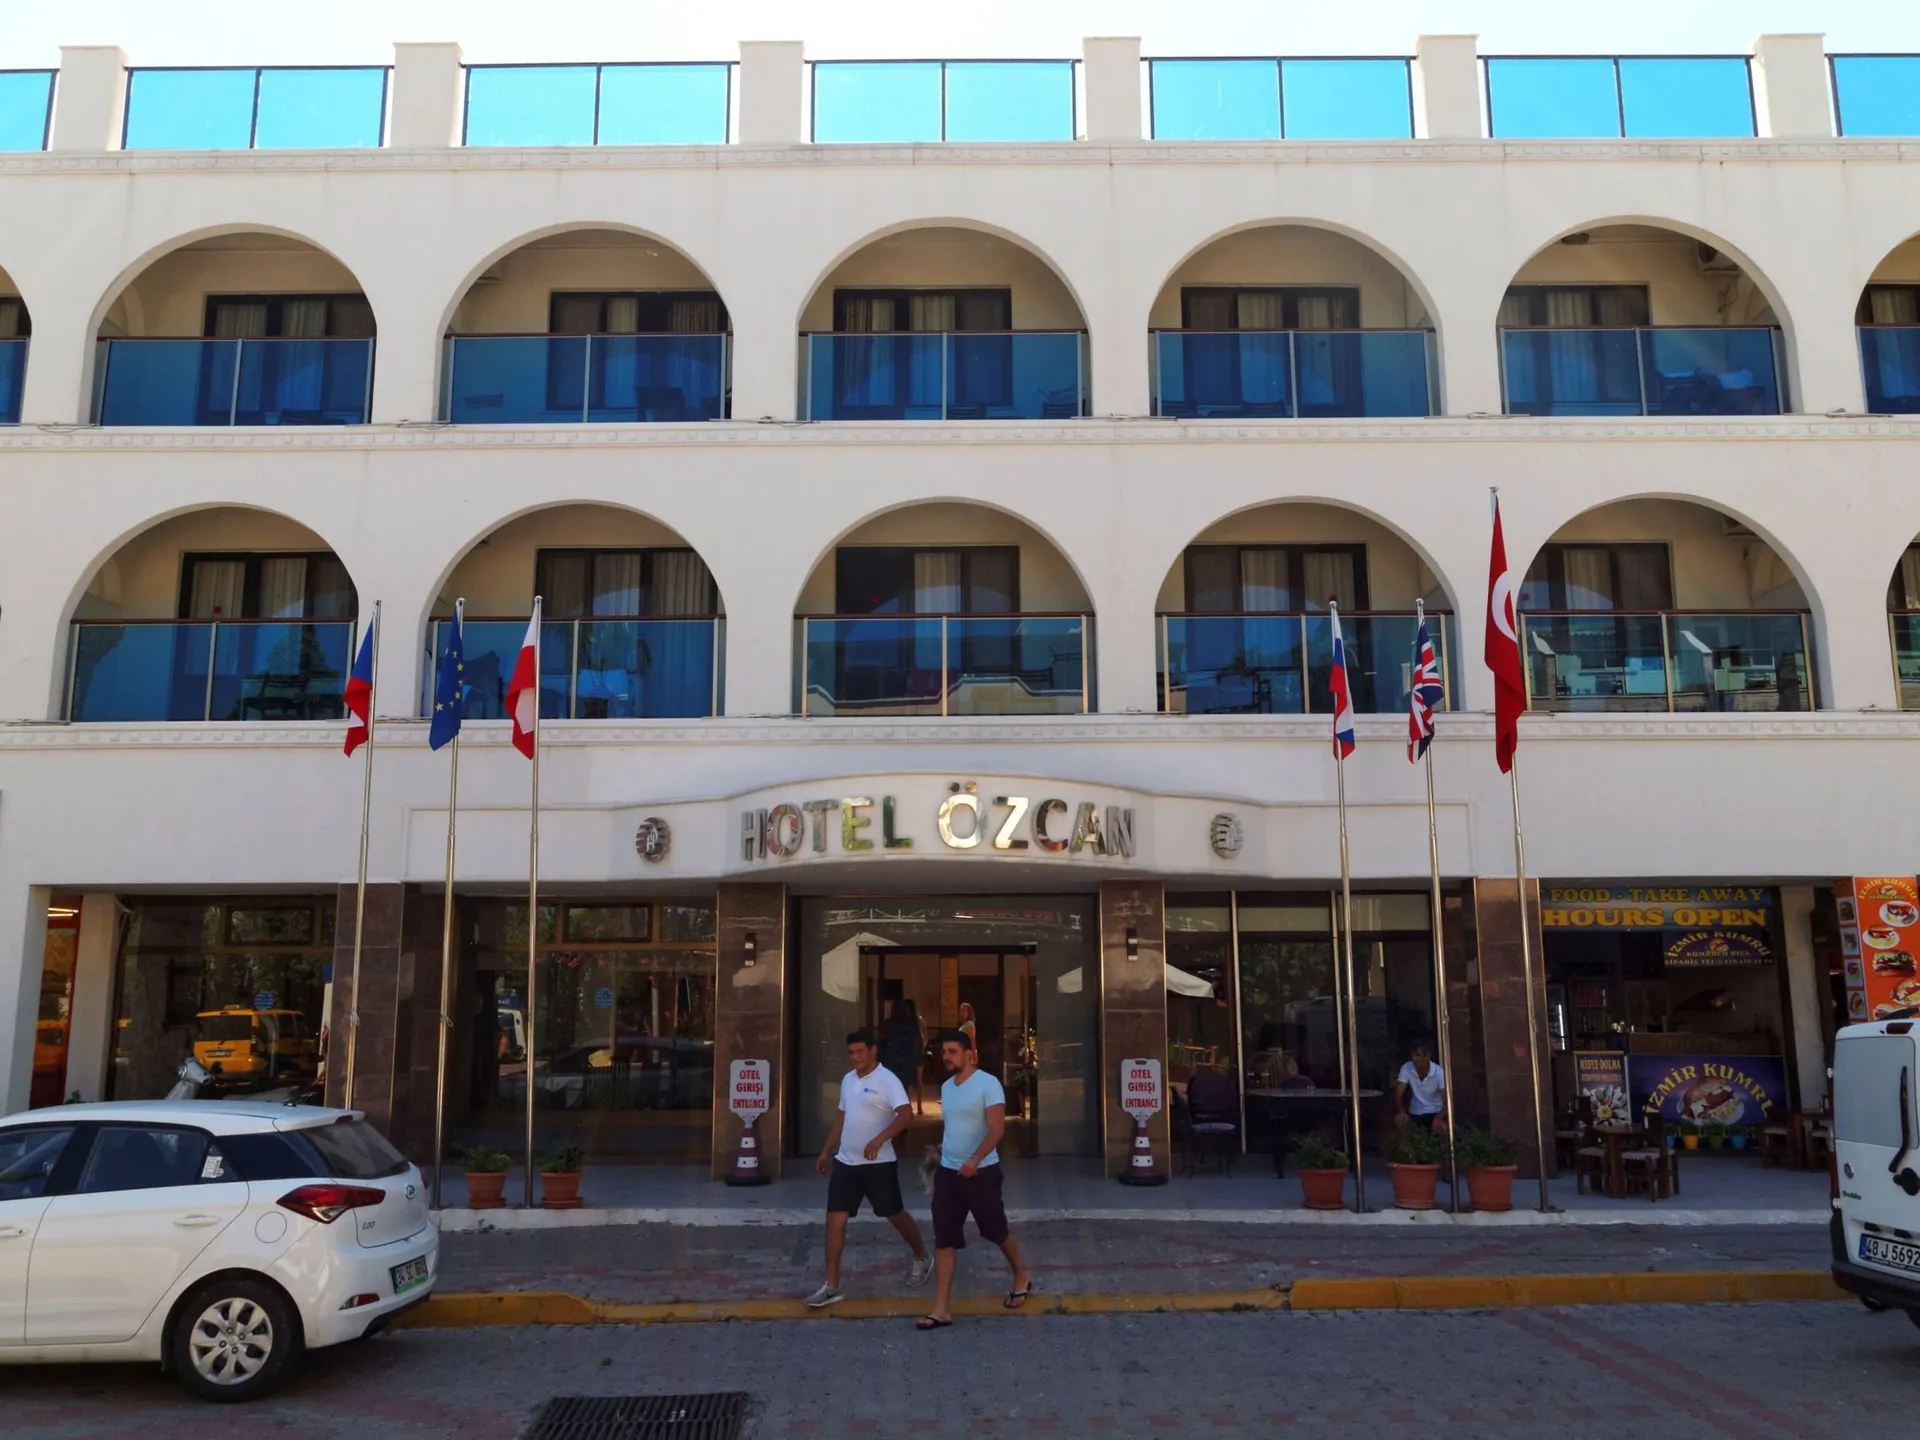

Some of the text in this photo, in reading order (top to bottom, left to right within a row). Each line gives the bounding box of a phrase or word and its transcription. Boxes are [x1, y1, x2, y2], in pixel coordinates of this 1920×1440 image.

[741, 781, 1137, 861] HOTEL ÖZCAN
[1551, 888, 1611, 902] FOOD
[1628, 887, 1689, 902] TAKE
[1698, 887, 1764, 902] AWAY
[1542, 907, 1767, 927] HOURS OPEN
[739, 1069, 761, 1080] OTEL
[1130, 1069, 1152, 1079] OTEL
[736, 1081, 764, 1095] GİRİŞİ
[1128, 1081, 1155, 1094] GİRİŞİ
[1642, 1065, 1698, 1113] İZMİR
[733, 1098, 766, 1109] ENTRANCE
[1125, 1098, 1159, 1108] ENTRANCE
[1866, 1239, 1879, 1256] 48
[1881, 1244, 1889, 1259] J
